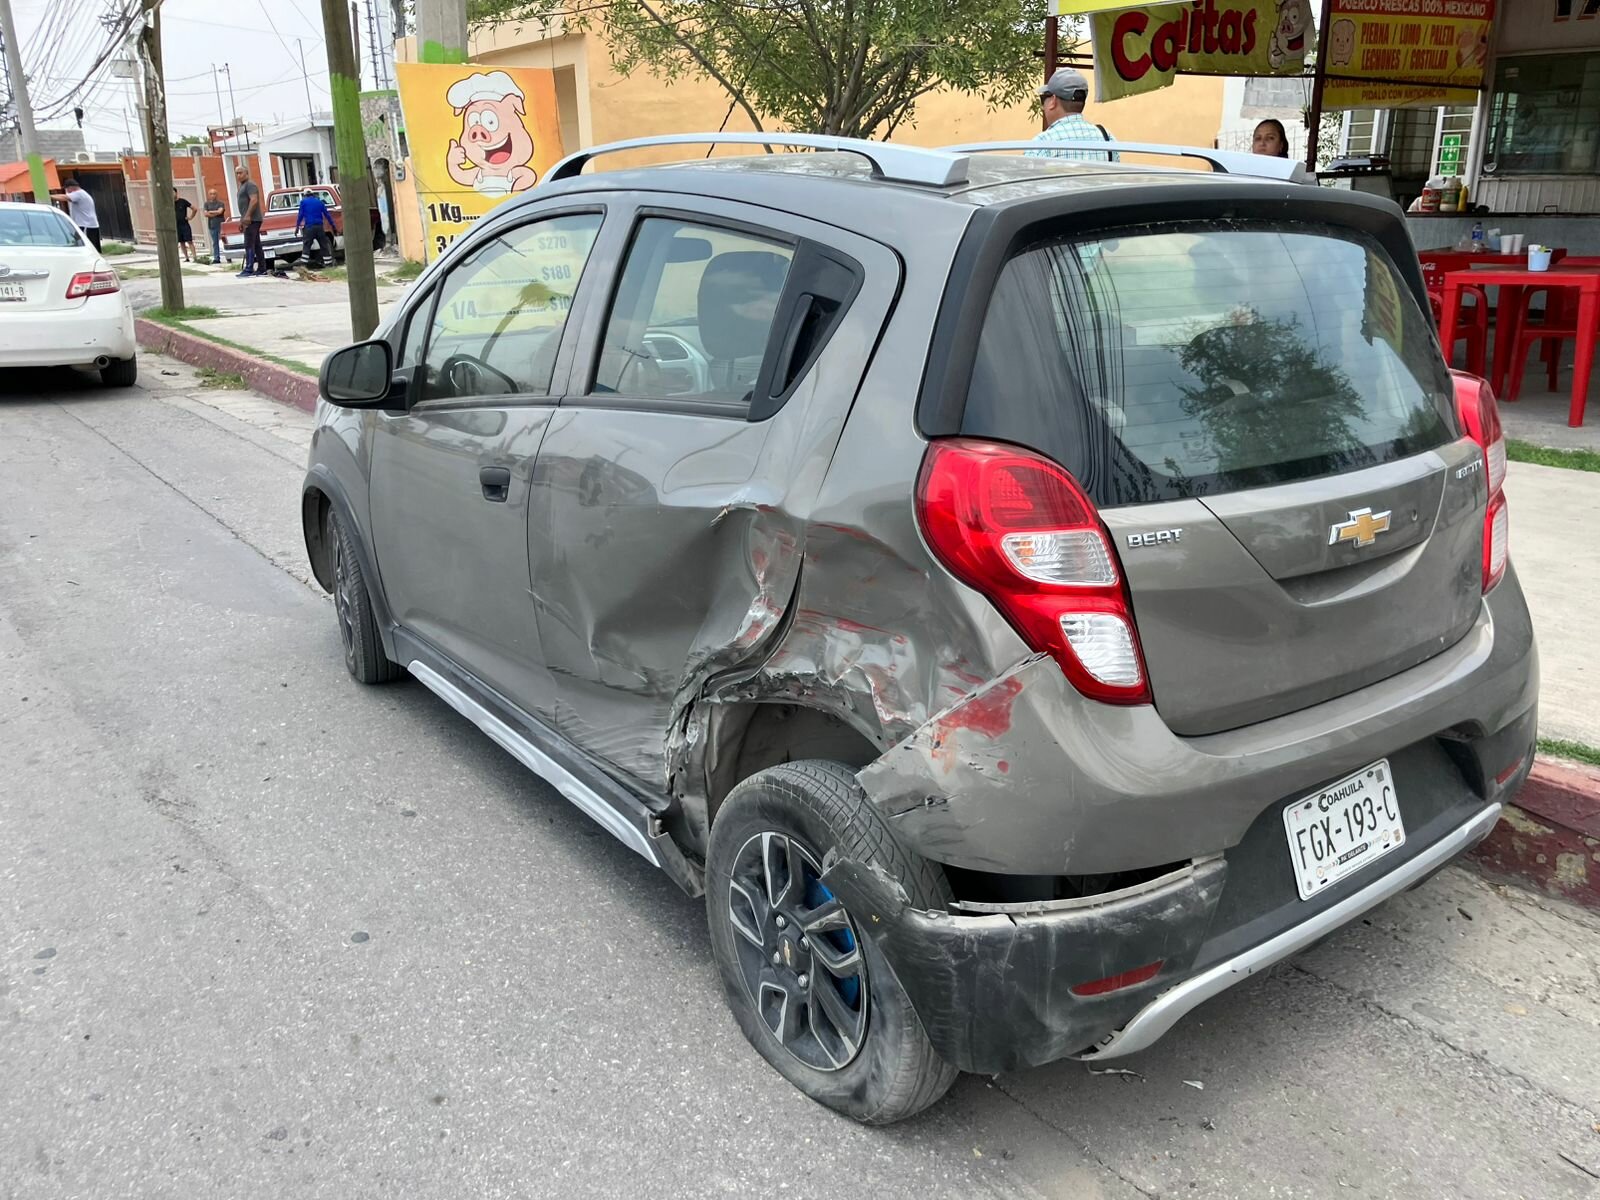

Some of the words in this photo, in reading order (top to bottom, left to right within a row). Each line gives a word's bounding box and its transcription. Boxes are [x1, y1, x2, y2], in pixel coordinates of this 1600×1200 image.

[1379, 0, 1420, 13] FRESCAS
[1422, 0, 1443, 14] 100%
[1444, 1, 1486, 17] MEXICANO
[1361, 22, 1390, 46] PIERNA
[1399, 23, 1422, 46] LOMO
[1409, 49, 1449, 71] COSTILLAR
[428, 203, 437, 222] 1
[538, 236, 567, 250] $270
[542, 265, 572, 281] $180
[1295, 785, 1396, 870] FGX-193-C
